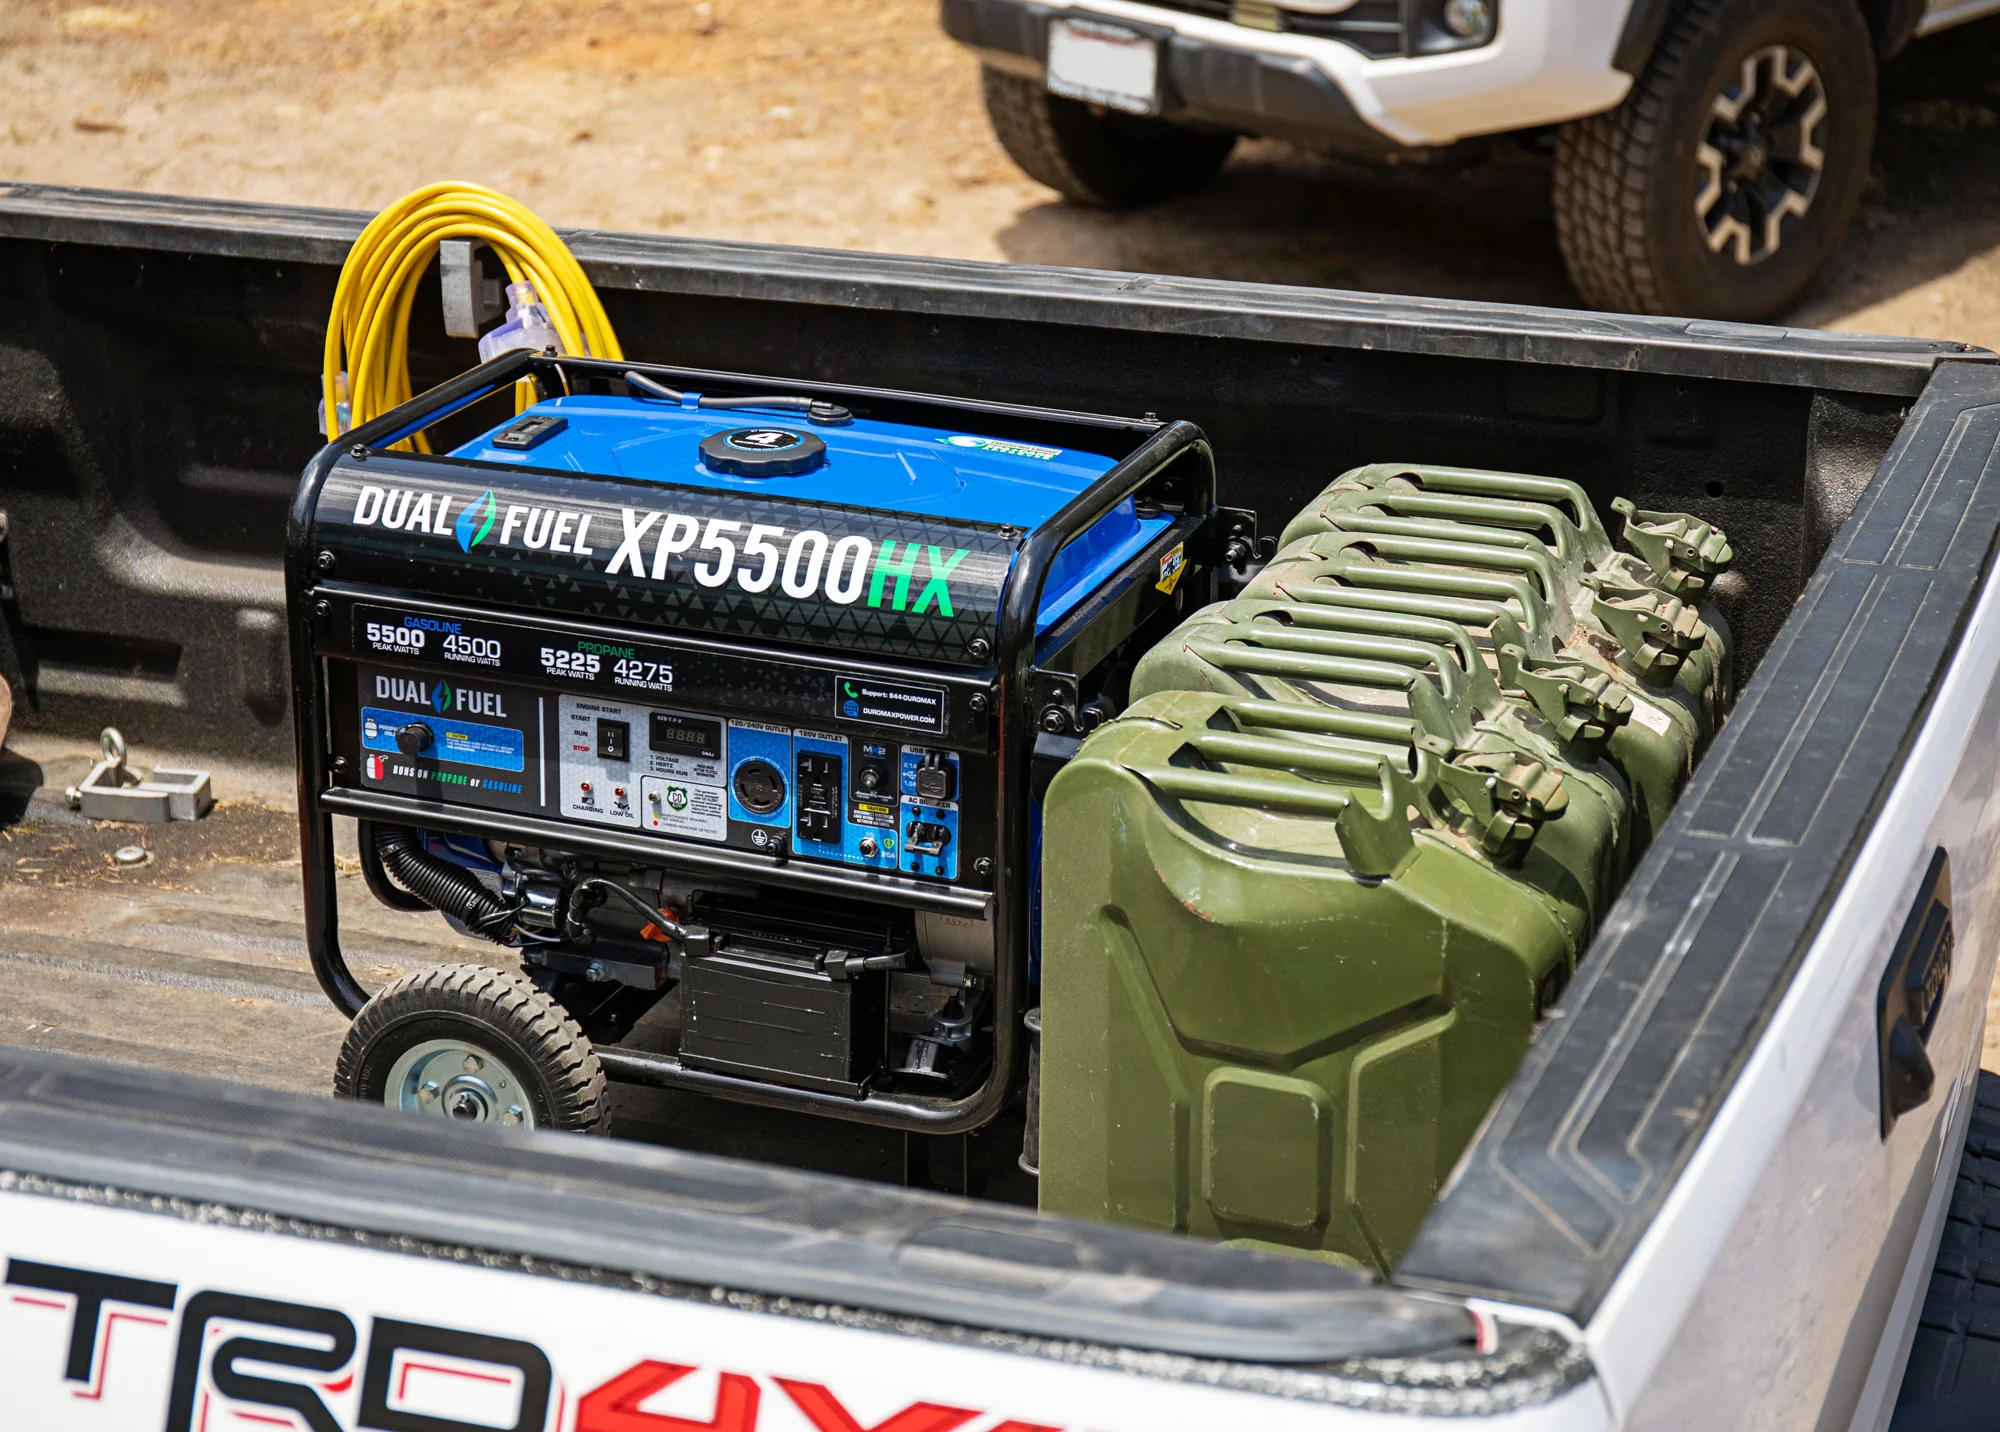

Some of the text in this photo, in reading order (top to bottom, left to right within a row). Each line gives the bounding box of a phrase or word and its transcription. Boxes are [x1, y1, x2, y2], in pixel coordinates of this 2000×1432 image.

[353, 485, 970, 617] DUAL FUEL XP5500HX
[404, 616, 462, 635] GASOLINE
[367, 623, 501, 659] 5500 4500
[372, 641, 419, 655] PEAK WATTS
[577, 641, 635, 659] PROPANE
[444, 652, 500, 667] RUNNING WATTS
[540, 648, 673, 684] 5225 4275
[546, 667, 595, 681] PEAK WATTS
[614, 677, 673, 692] RUNNING WATTS
[376, 675, 507, 718] DUAL FUEL
[862, 688, 936, 705] Support: 844-DUROMAX
[576, 703, 622, 715] ENGINE START
[863, 707, 935, 724] DUROMAXPOWER.COM
[571, 714, 590, 722] START
[730, 719, 789, 734] 120/240V OUTLET
[799, 730, 843, 742] 120V OUTLET
[572, 744, 590, 752] STOP
[655, 755, 679, 763] VOLTAGE
[655, 767, 675, 775] HOURS
[393, 765, 414, 776] RUNS
[417, 768, 428, 779] ON
[431, 771, 467, 786] PROPANE
[482, 779, 522, 794] GASOLINE
[672, 793, 683, 803] CO
[572, 804, 604, 814] CHARGING
[4, 1258, 553, 1432] TRD
